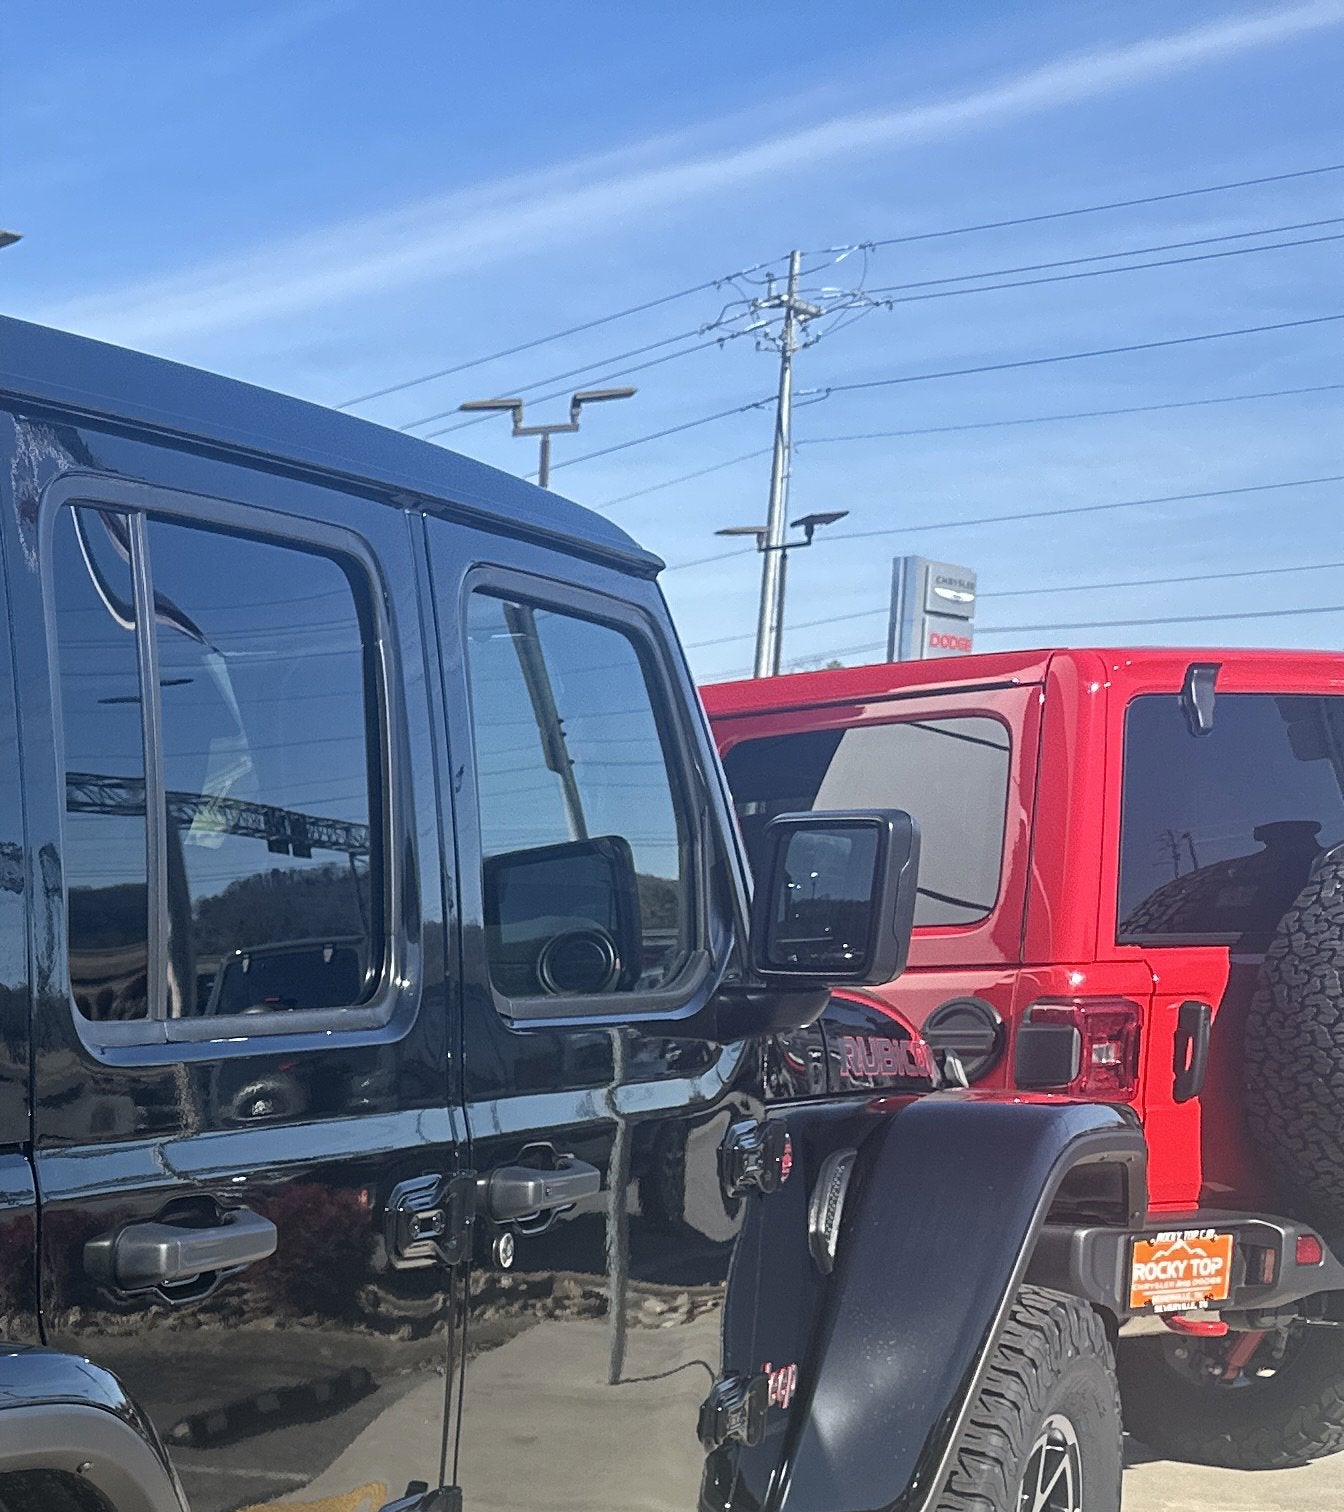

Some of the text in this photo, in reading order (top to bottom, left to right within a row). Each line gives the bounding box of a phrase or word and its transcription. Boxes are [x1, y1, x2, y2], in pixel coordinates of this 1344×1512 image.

[935, 575, 975, 590] CHRYSLER
[928, 632, 973, 652] DODGE
[1132, 1257, 1223, 1281] ROCKY TOP
